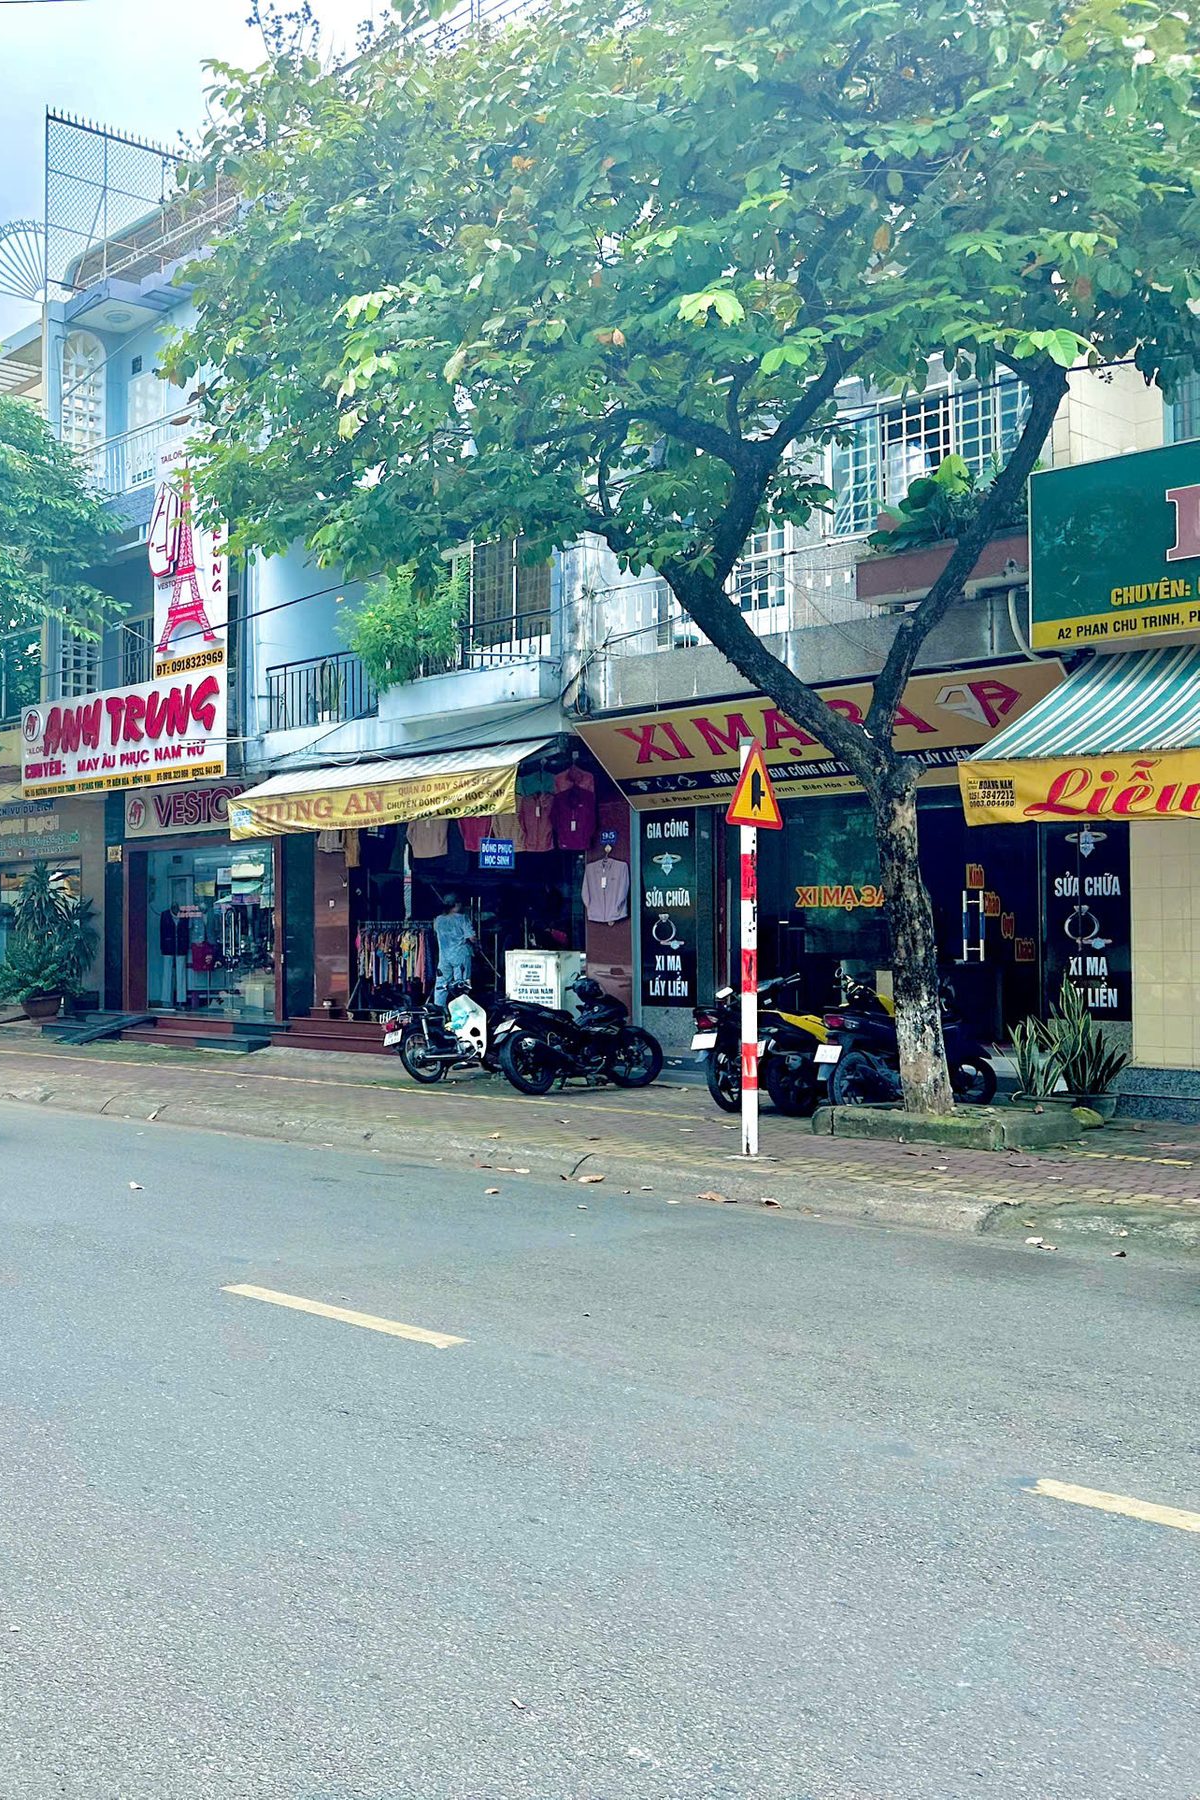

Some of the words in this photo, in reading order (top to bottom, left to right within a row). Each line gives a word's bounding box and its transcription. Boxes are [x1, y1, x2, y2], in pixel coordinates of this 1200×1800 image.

[160, 450, 183, 464] TAILOR
[157, 579, 176, 591] VESTO
[1110, 577, 1192, 606] CHUYÊN:
[1057, 627, 1072, 640] A2
[1076, 623, 1108, 637] PHAN
[1113, 618, 1137, 633] CHU
[1142, 612, 1185, 629] TRINH,
[156, 663, 170, 676] ĐT:
[171, 651, 224, 673] 0918323969
[43, 698, 103, 756] ANH
[106, 675, 220, 746] TRUNG
[615, 721, 696, 764] XI
[690, 707, 819, 757] MẠ
[77, 757, 101, 772] MAY
[120, 750, 149, 768] PHỤC
[154, 745, 182, 762] NAM
[768, 767, 789, 779] GIA
[787, 764, 820, 777] CÔNG
[918, 749, 942, 765] LẤY
[433, 781, 450, 792] MAY
[342, 790, 385, 816] AN
[602, 832, 615, 840] 95
[646, 823, 662, 839] GIA
[664, 818, 689, 838] CÔNG
[645, 886, 663, 907] SỬA
[665, 887, 690, 907] CHỮA
[1054, 871, 1080, 897] SỬA
[1084, 872, 1121, 896] CHỮA
[795, 886, 819, 907] XI
[821, 885, 860, 911] MẠ
[655, 955, 665, 971] XI
[666, 954, 682, 975] MẠ
[1069, 956, 1082, 976] XI
[1086, 956, 1108, 981] MẠ
[649, 975, 667, 996] LẤY
[1088, 980, 1118, 1008] LIỀN
